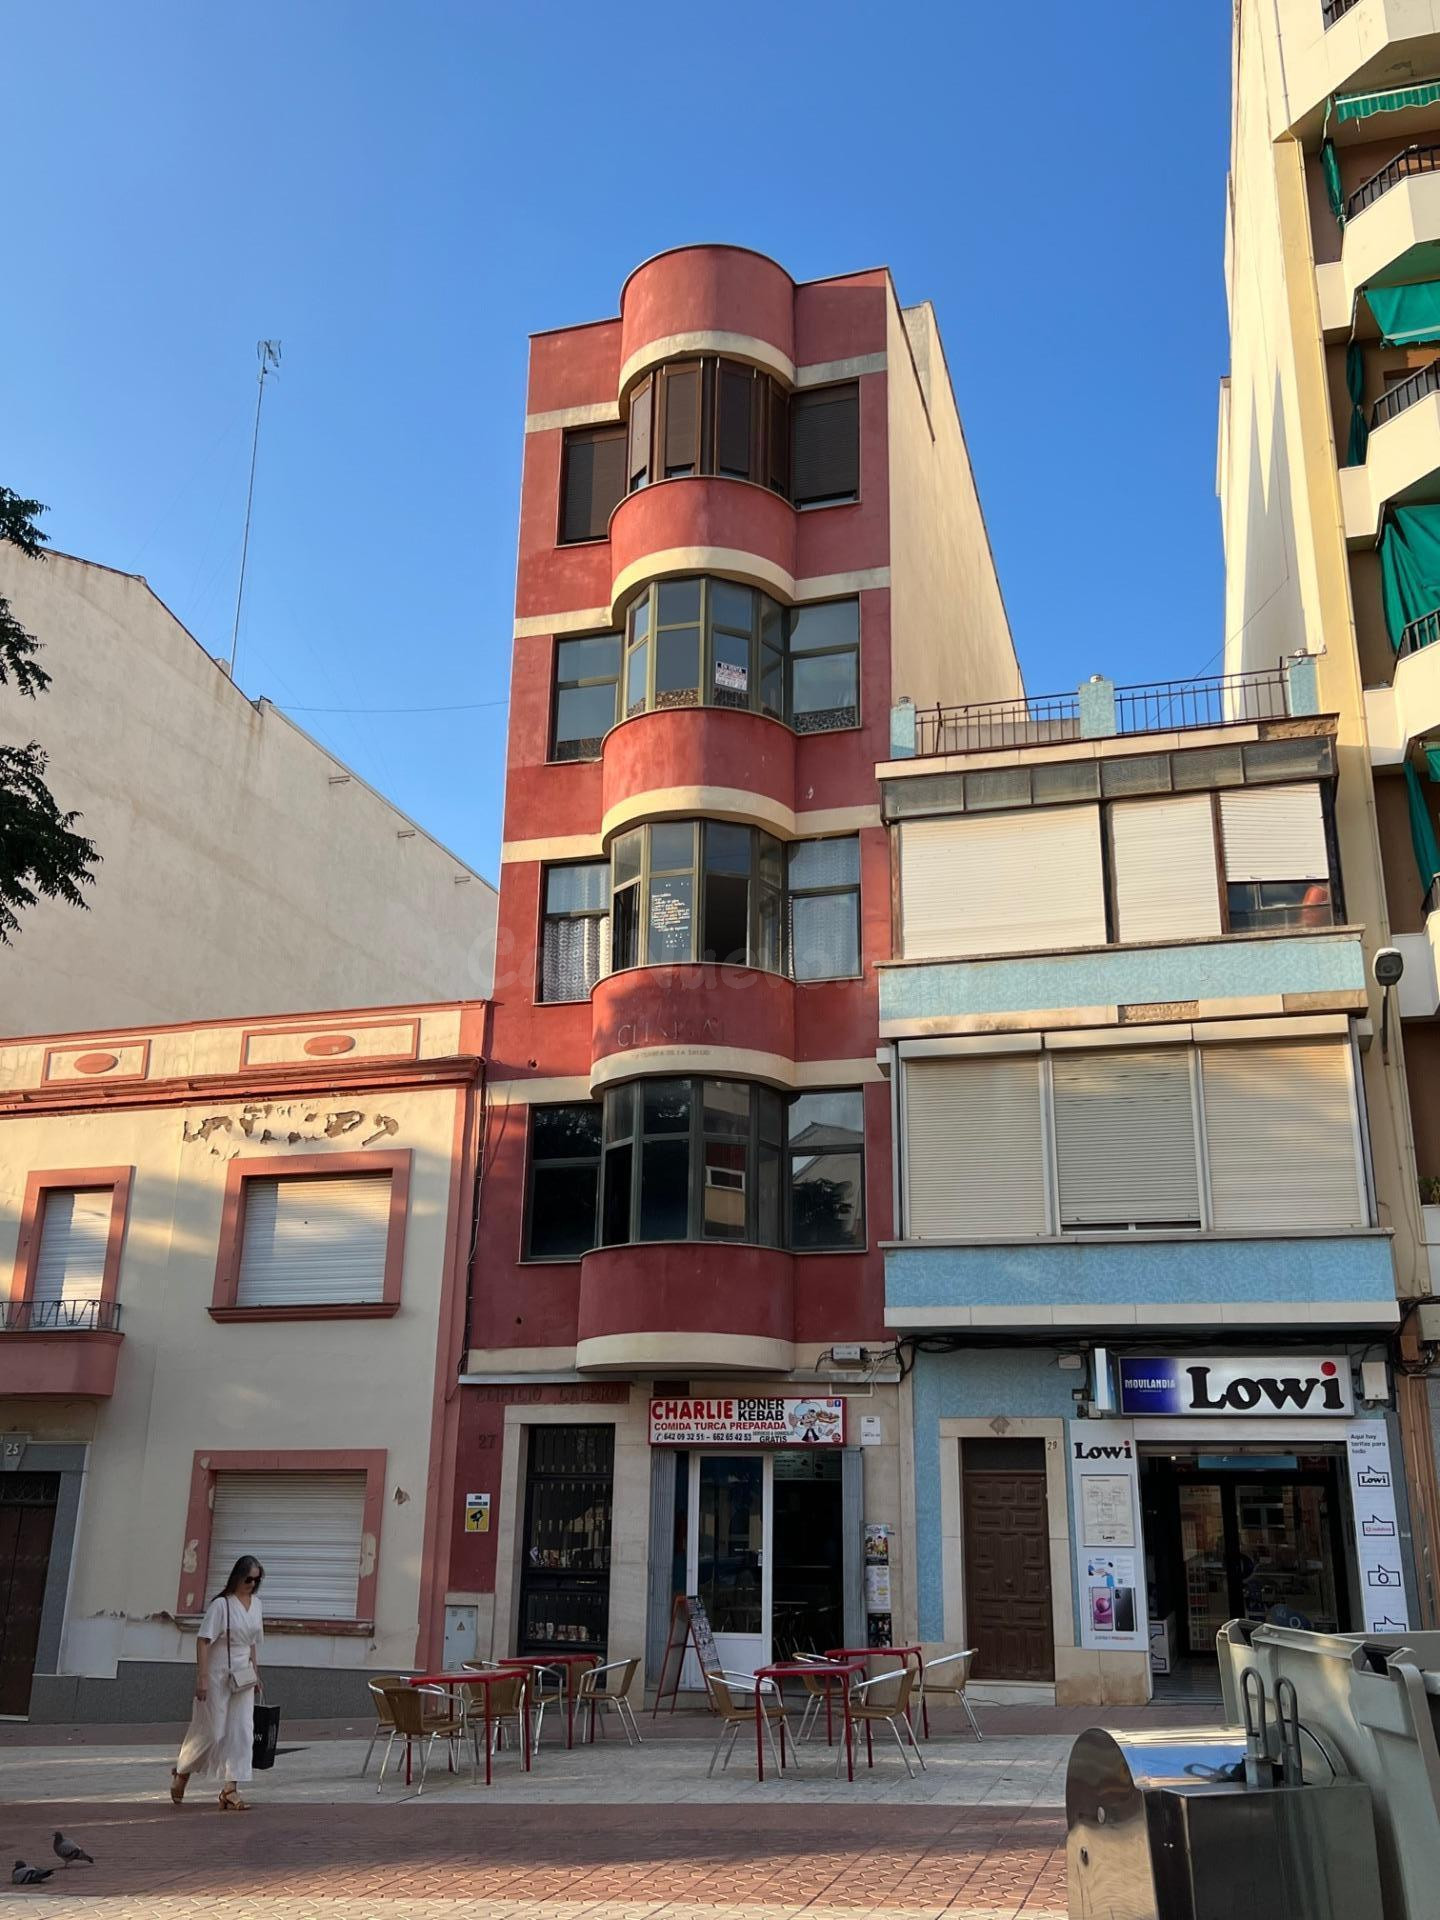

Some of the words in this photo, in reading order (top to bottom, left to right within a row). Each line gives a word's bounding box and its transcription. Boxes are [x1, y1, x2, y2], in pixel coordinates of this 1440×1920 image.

[1124, 1378, 1176, 1389] MOVILANDIA
[1186, 1360, 1344, 1411] Lowi
[651, 1400, 734, 1420] CHARLIE
[737, 1399, 785, 1410] DONER
[737, 1410, 785, 1421] KEBAB
[654, 1422, 692, 1431] COMIDA
[694, 1422, 727, 1431] TURCA
[729, 1421, 788, 1431] PREPARADA
[479, 1433, 497, 1449] 27
[759, 1435, 788, 1444] GRATIS
[5, 1442, 20, 1455] 25
[1047, 1440, 1058, 1451] 29
[1074, 1440, 1132, 1459] Lowi
[1361, 1475, 1386, 1483] Lowi
